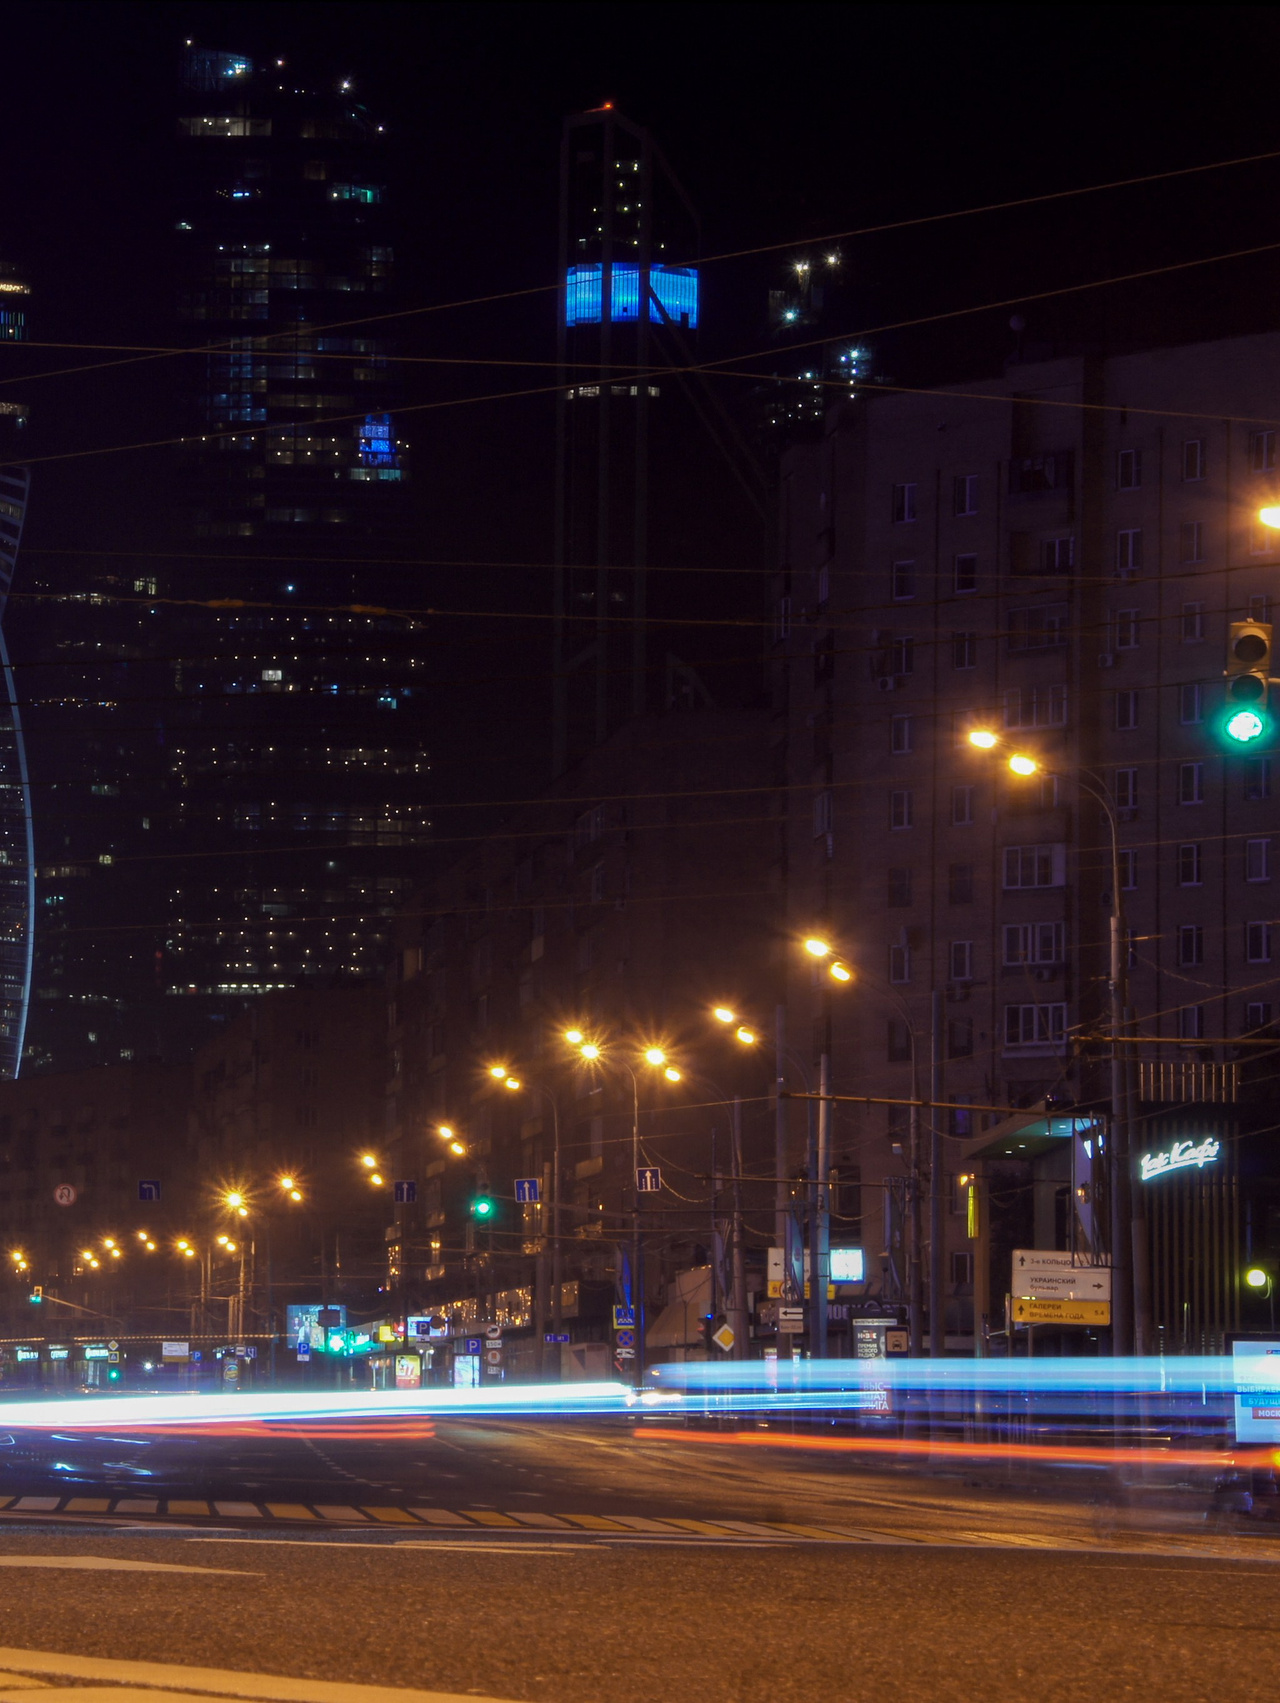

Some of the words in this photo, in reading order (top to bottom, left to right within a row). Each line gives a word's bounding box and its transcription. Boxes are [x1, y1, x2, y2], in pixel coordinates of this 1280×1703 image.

[1042, 1258, 1071, 1266] КОЛЬЦО
[1030, 1277, 1076, 1285] УКРАИНСКИЙ
[1030, 1284, 1059, 1292] бульвар
[469, 1340, 478, 1352] P
[1248, 1397, 1280, 1406] БУДУЩ
